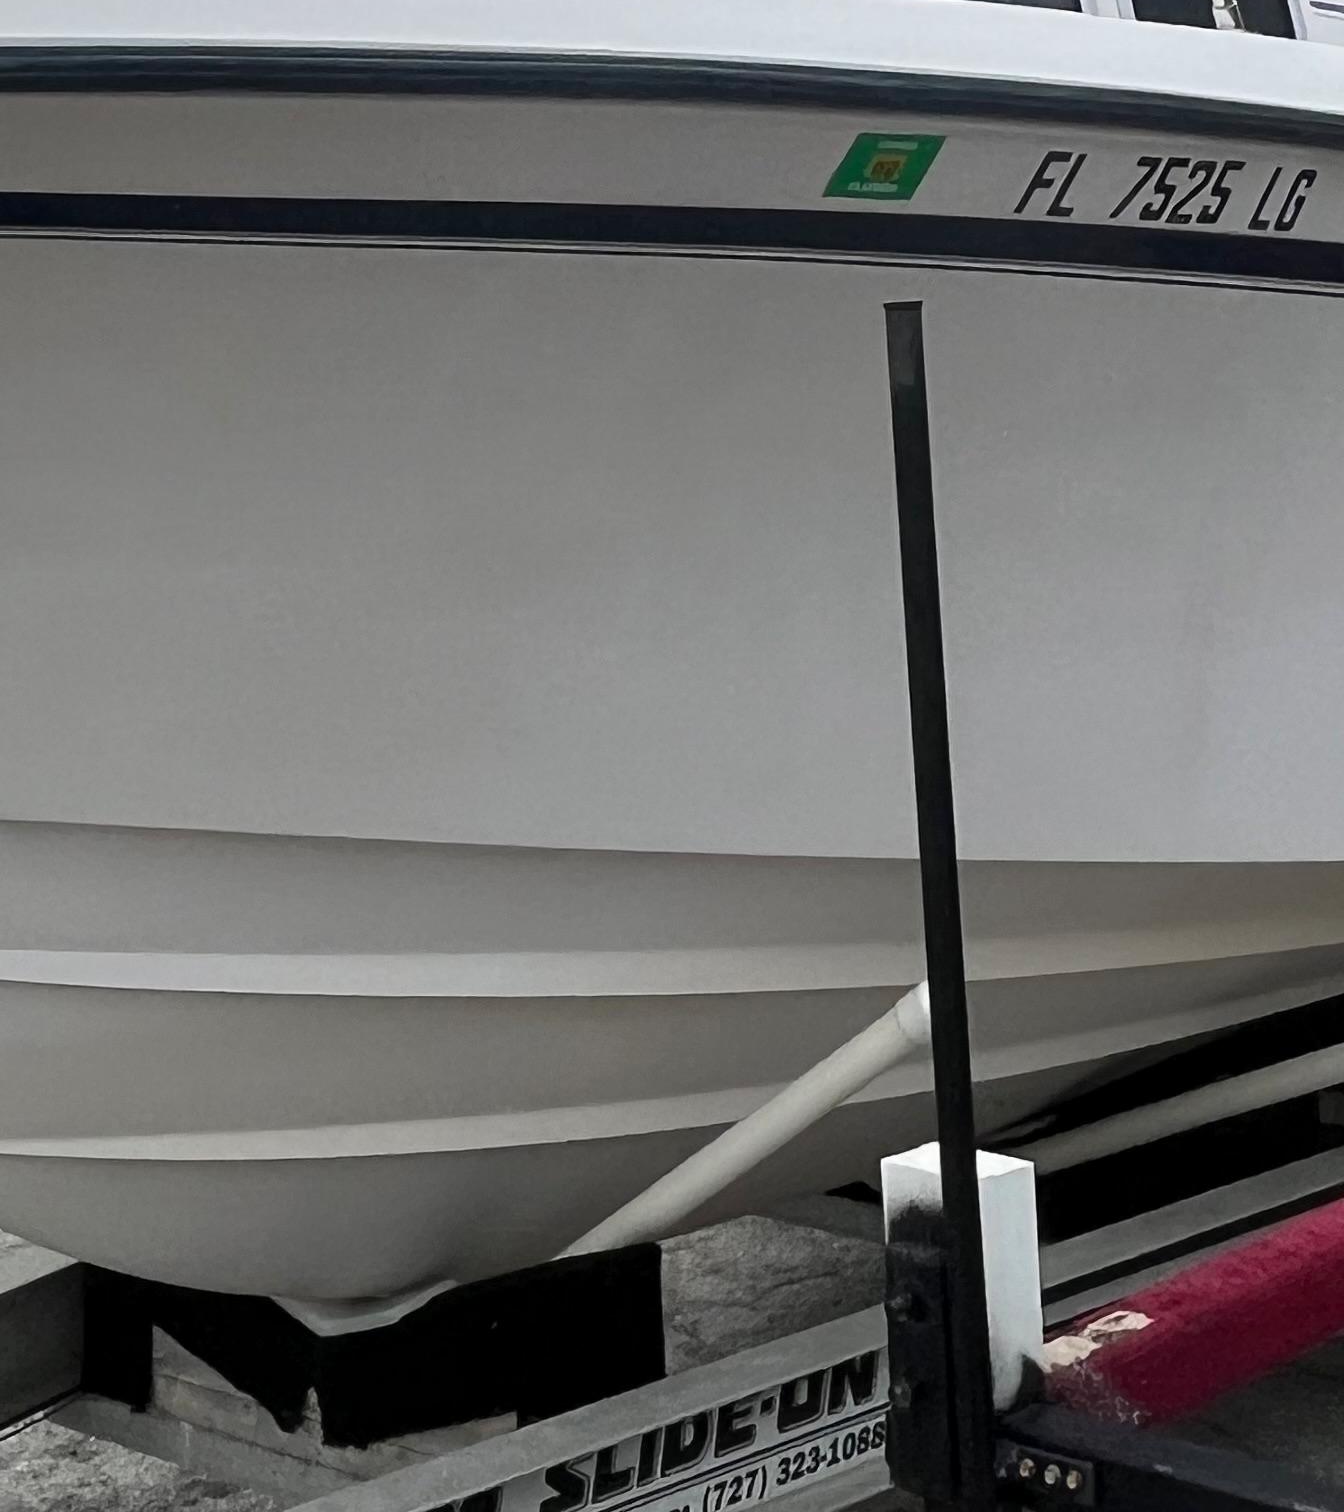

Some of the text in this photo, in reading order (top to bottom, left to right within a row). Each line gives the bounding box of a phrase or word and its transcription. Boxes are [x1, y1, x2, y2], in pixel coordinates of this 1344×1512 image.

[1013, 150, 1318, 232] FL 7525 LG
[539, 1349, 880, 1512] SLIDE-ON
[702, 1464, 768, 1512] (727)
